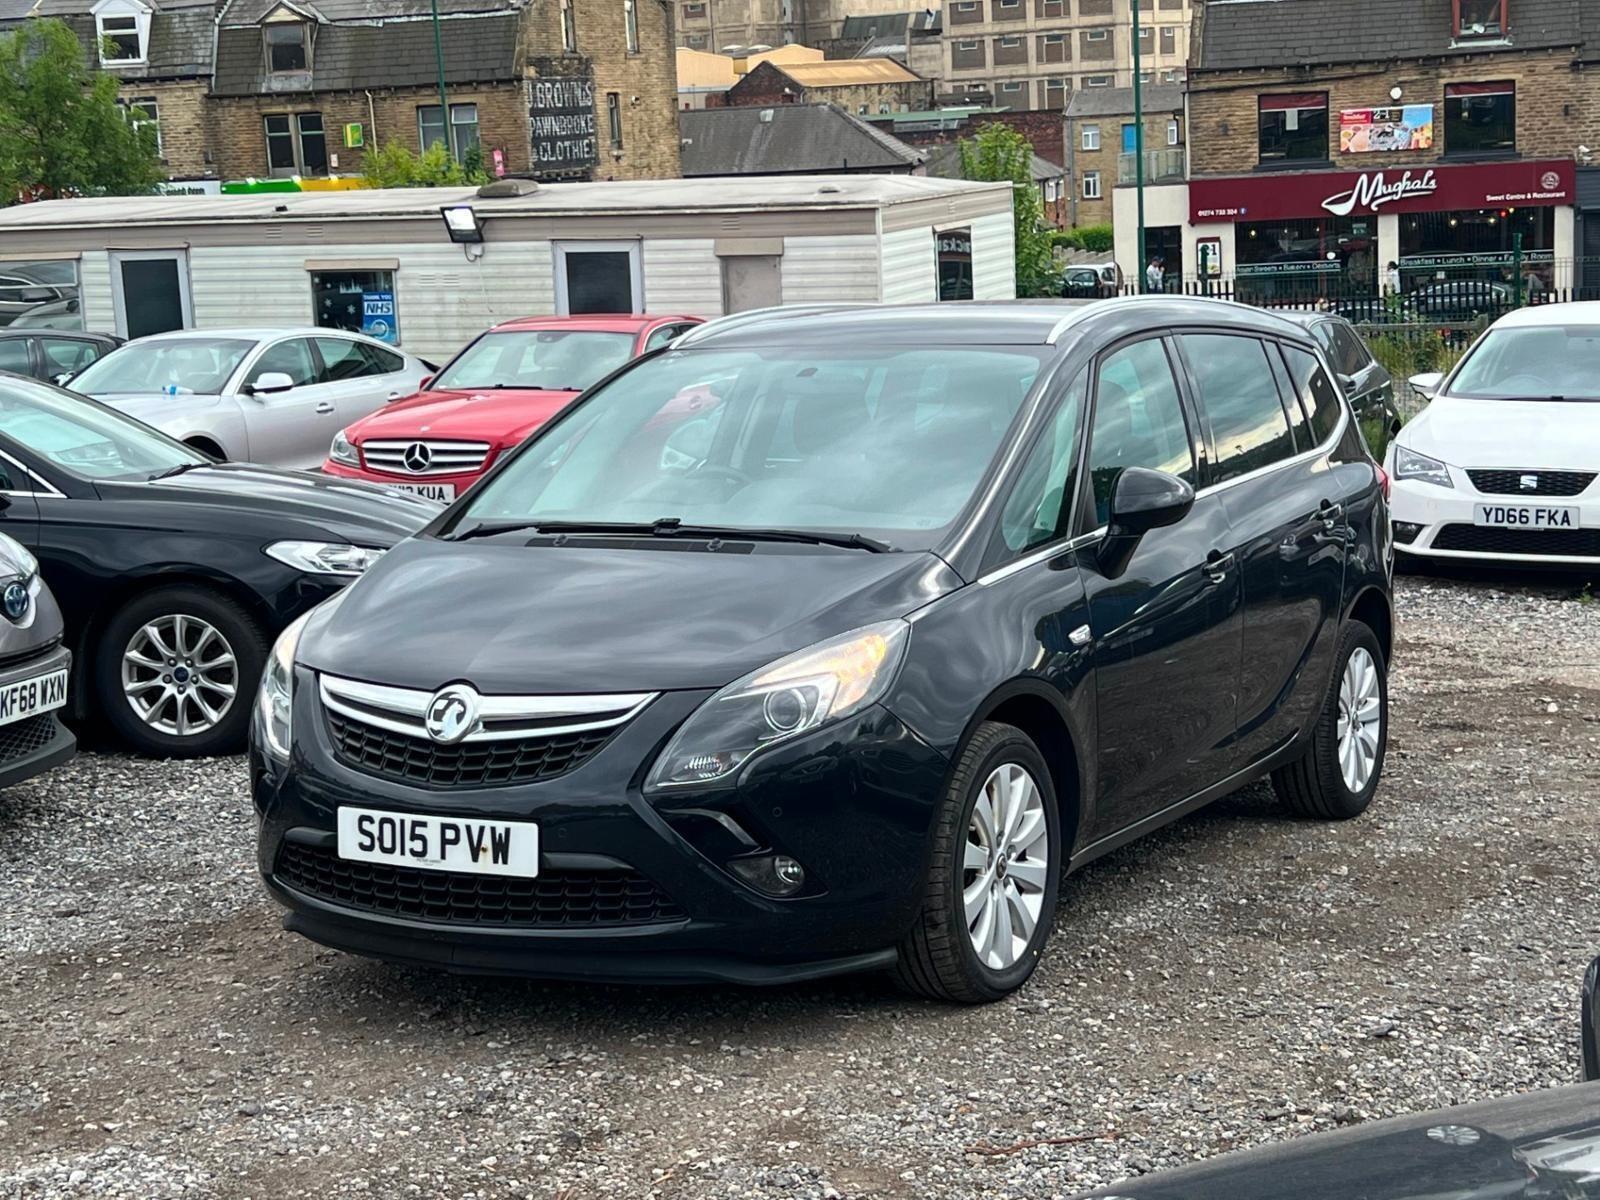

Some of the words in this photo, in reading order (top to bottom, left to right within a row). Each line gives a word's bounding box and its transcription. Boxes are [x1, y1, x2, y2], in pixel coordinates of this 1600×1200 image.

[1321, 169, 1438, 216] Mughals
[1505, 193, 1526, 201] Centre
[1532, 191, 1566, 199] Restaurant
[1311, 261, 1340, 270] Desserts
[1400, 258, 1435, 266] Breakfast
[1441, 257, 1465, 265] Lunch
[1472, 255, 1497, 263] Dinner
[1530, 252, 1553, 261] Room
[366, 303, 391, 314] NHS
[1482, 507, 1530, 525] YD66
[1535, 509, 1571, 526] FKA
[0, 682, 37, 719] KF68
[40, 673, 65, 706] WXN
[357, 814, 428, 858] SO15
[440, 822, 511, 865] PVW
